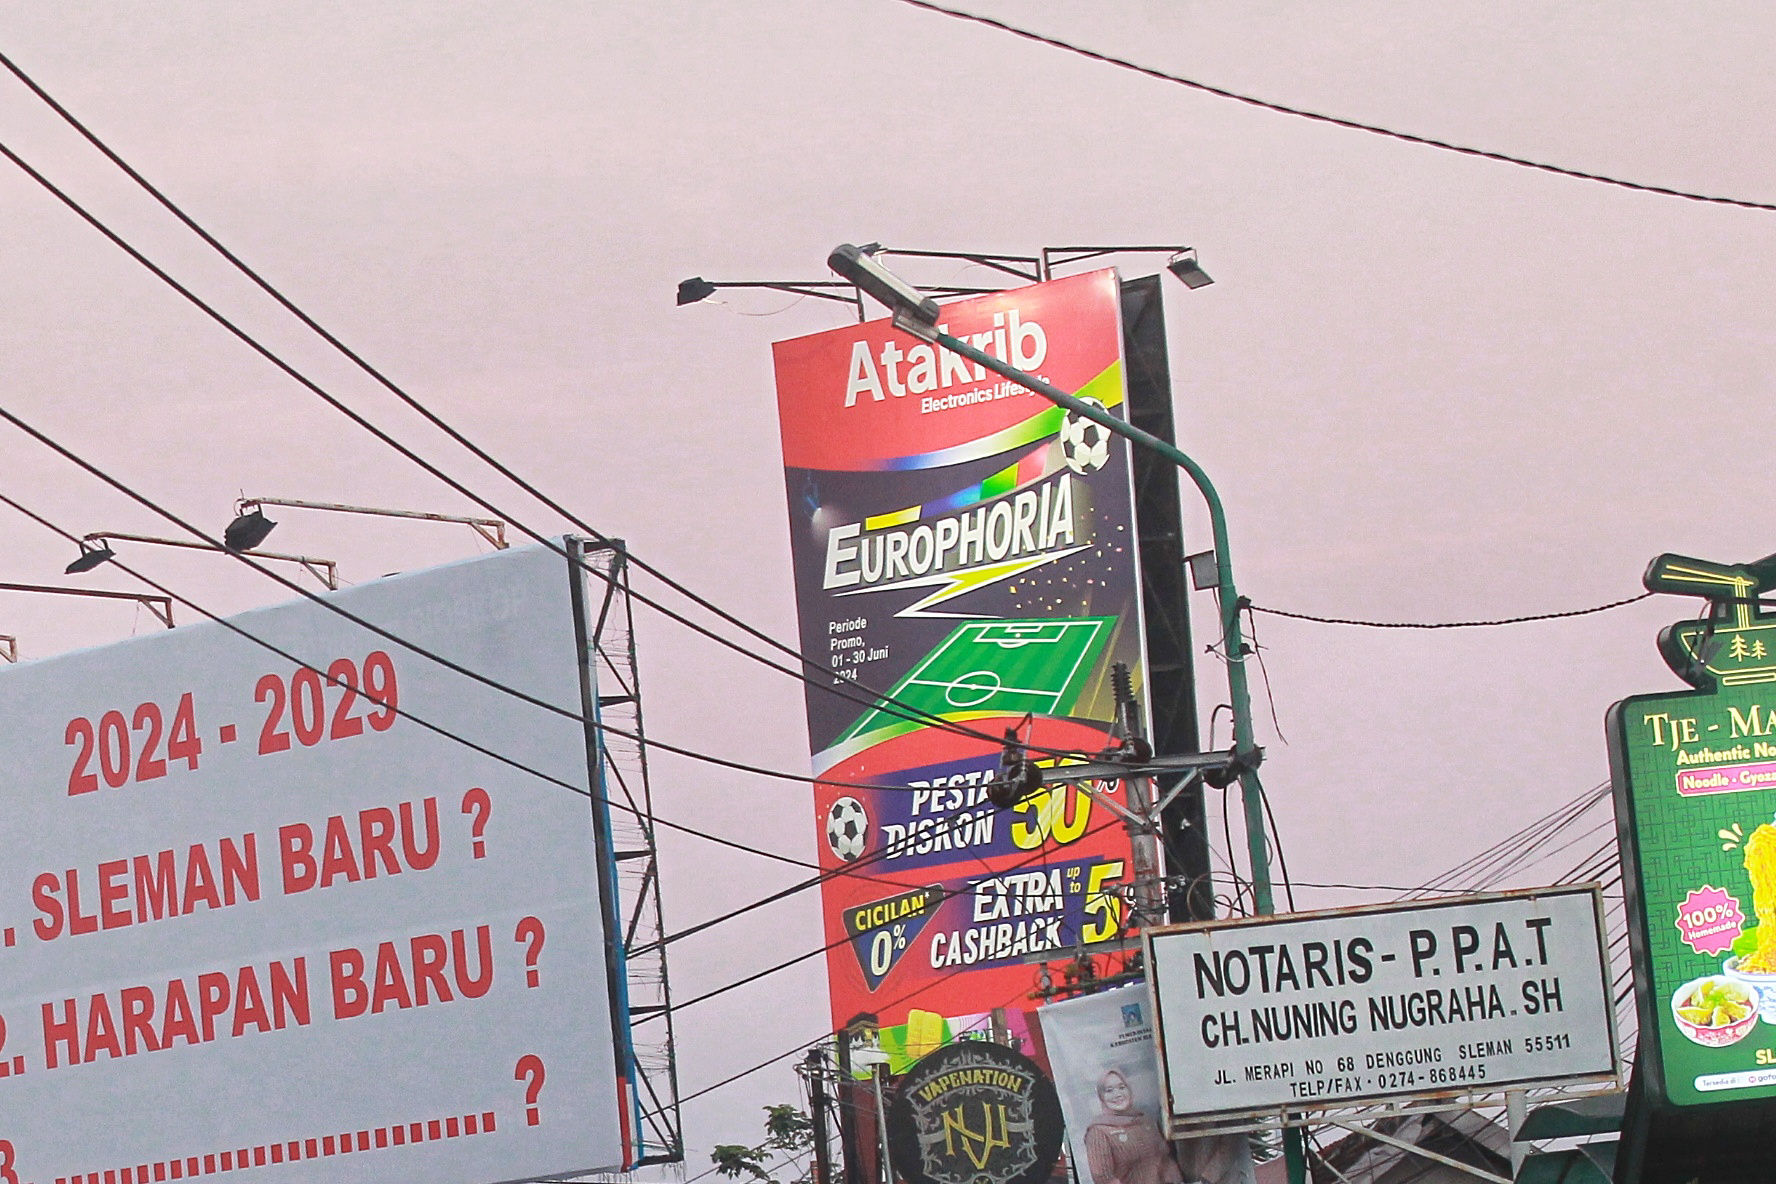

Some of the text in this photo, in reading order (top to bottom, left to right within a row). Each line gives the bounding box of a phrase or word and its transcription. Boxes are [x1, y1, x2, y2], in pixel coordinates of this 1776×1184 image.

[844, 309, 1048, 407] Atakrib
[922, 387, 993, 414] Electronics
[829, 617, 867, 634] Periode
[830, 637, 865, 651] Promo,
[832, 654, 843, 667] 01
[853, 650, 865, 664] 30
[867, 645, 889, 661] Juni
[65, 692, 202, 796] 2024
[254, 651, 399, 757] 2029
[1676, 744, 1751, 766] Authentic
[908, 769, 995, 816] PESTA
[1683, 773, 1729, 789] Noodle
[881, 809, 994, 860] DISKON
[32, 832, 260, 941] SLEMAN
[279, 797, 440, 895] BARU
[461, 787, 491, 859] ?
[1070, 882, 1081, 893] to
[968, 868, 1064, 923] EXTRA
[1067, 866, 1080, 879] up
[1683, 903, 1734, 929] 100%
[871, 924, 906, 976] 0%
[930, 916, 1064, 969] CASHBACK
[1688, 920, 1737, 940] Homemade
[42, 957, 310, 1070] HARAPAN
[330, 925, 494, 1020] BARU
[515, 917, 545, 989] ?
[1214, 1033, 1572, 1085] JL. MERAPI NO 68 DENGGUNG SLEMAN 55511
[514, 1054, 545, 1126] ?
[917, 1069, 1022, 1102] VAPENATION
